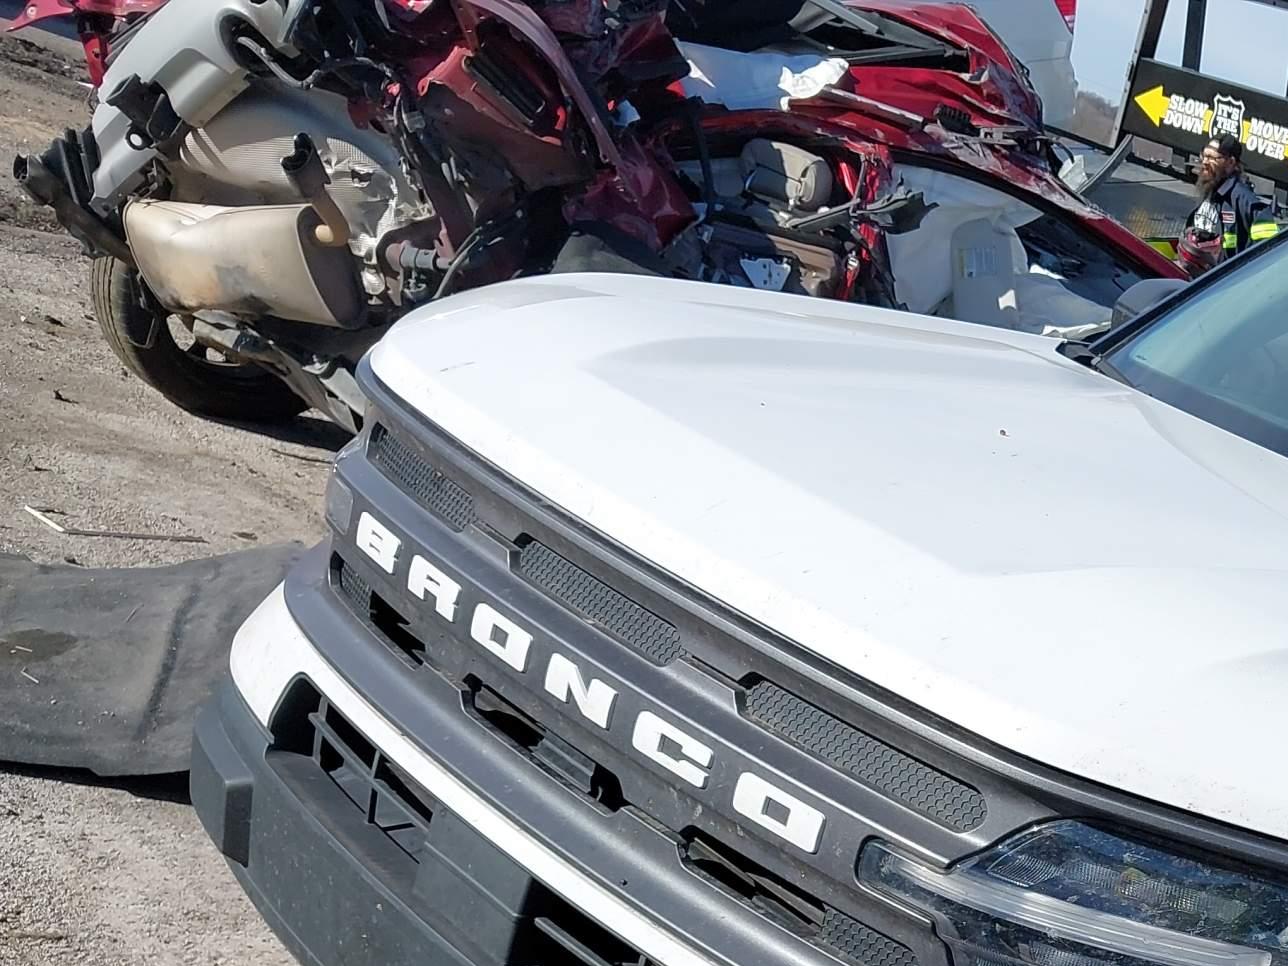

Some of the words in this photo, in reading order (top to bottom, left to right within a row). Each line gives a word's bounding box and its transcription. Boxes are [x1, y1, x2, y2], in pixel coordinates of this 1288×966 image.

[1168, 93, 1209, 118] SLOW
[1217, 103, 1240, 121] IT'S
[1163, 109, 1203, 135] DOWN
[1216, 116, 1239, 132] THE
[1246, 134, 1285, 160] OVER
[355, 511, 826, 855] BRONCO
